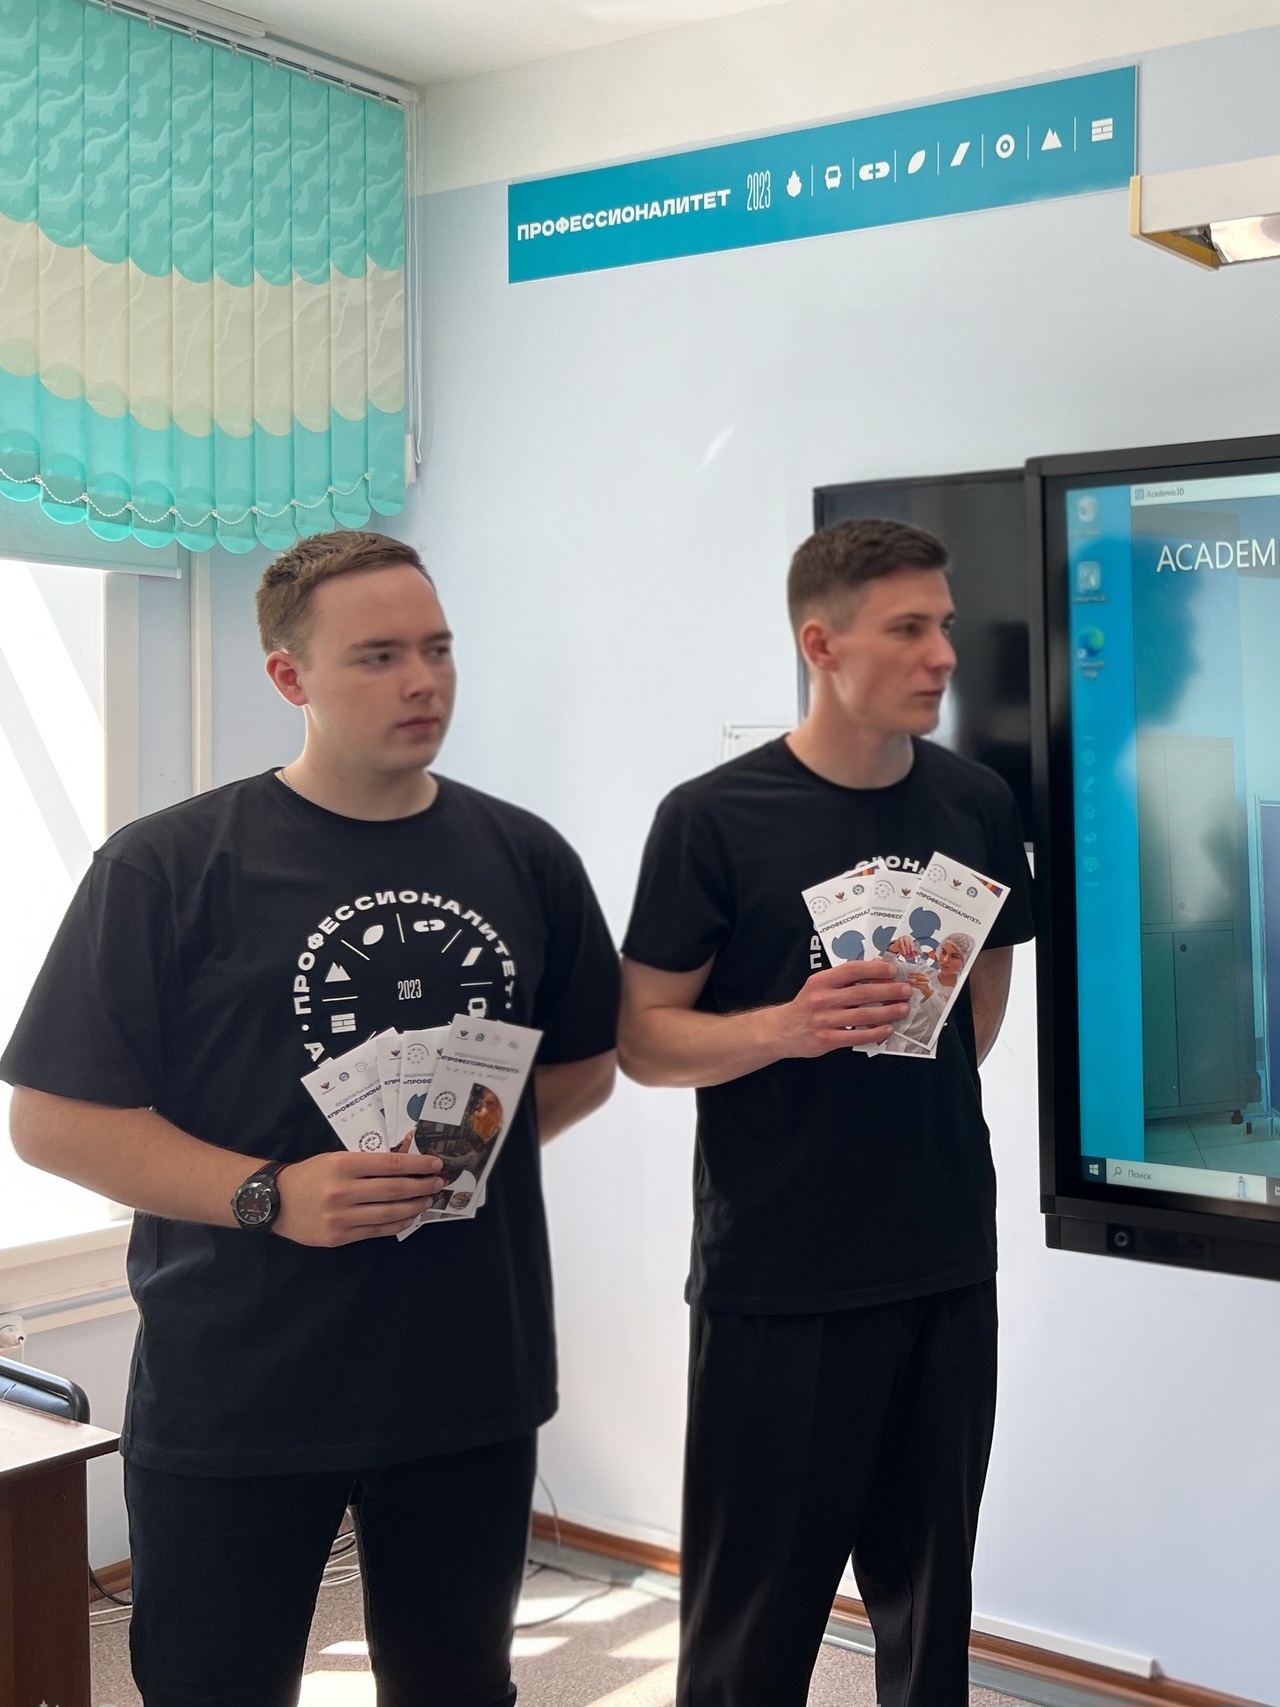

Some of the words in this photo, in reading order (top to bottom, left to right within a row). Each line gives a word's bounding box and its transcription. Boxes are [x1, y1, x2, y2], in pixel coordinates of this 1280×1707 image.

[516, 188, 732, 242] ПРОФЕССИОНАЛИТЕТ
[746, 170, 772, 212] 2023
[1146, 487, 1185, 499] Academix3D
[293, 890, 517, 1016] ПРОФЕССИОНАЛИТЕТ
[397, 978, 422, 1001] 2023
[1127, 1169, 1152, 1181] Поиск
